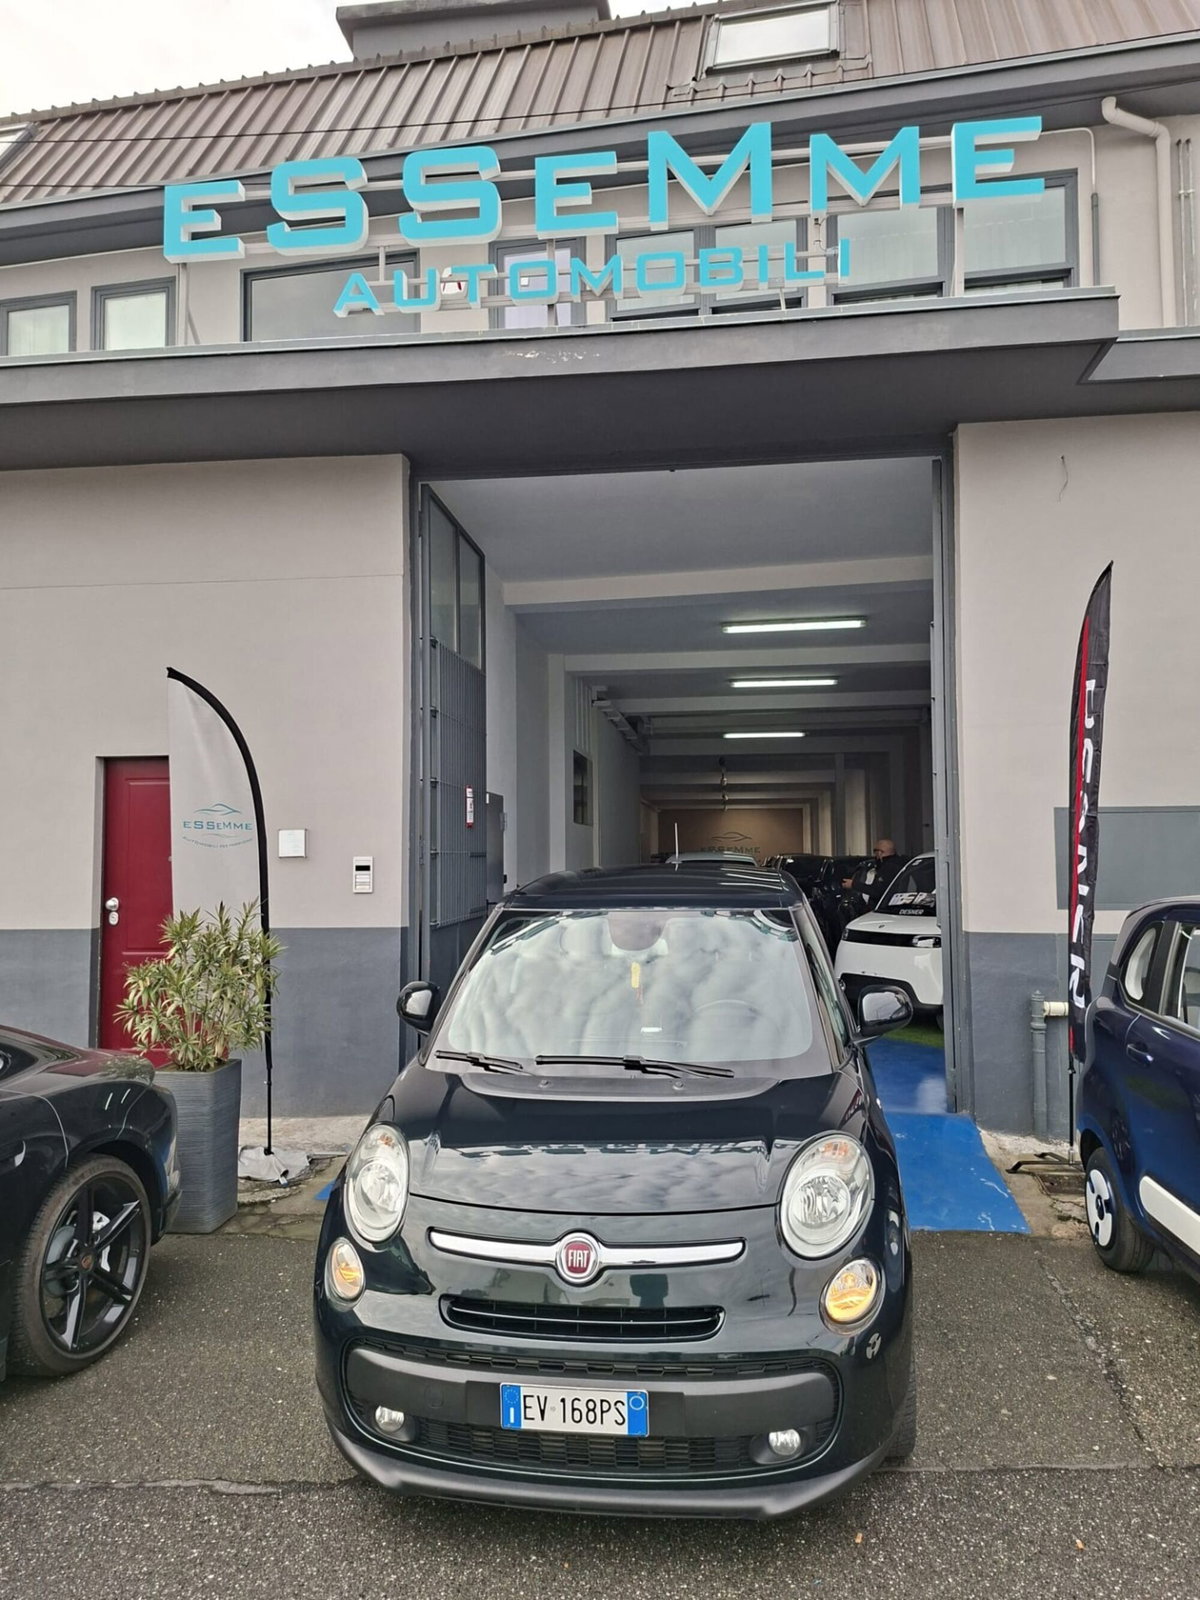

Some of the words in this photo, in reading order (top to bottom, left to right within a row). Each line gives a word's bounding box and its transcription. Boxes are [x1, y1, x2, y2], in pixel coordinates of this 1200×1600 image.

[163, 116, 1046, 262] ESSEMME
[333, 238, 850, 317] AUTOMOBILI
[568, 1250, 589, 1268] FIAT
[522, 1394, 548, 1421] EV
[559, 1397, 626, 1426] 168PS
